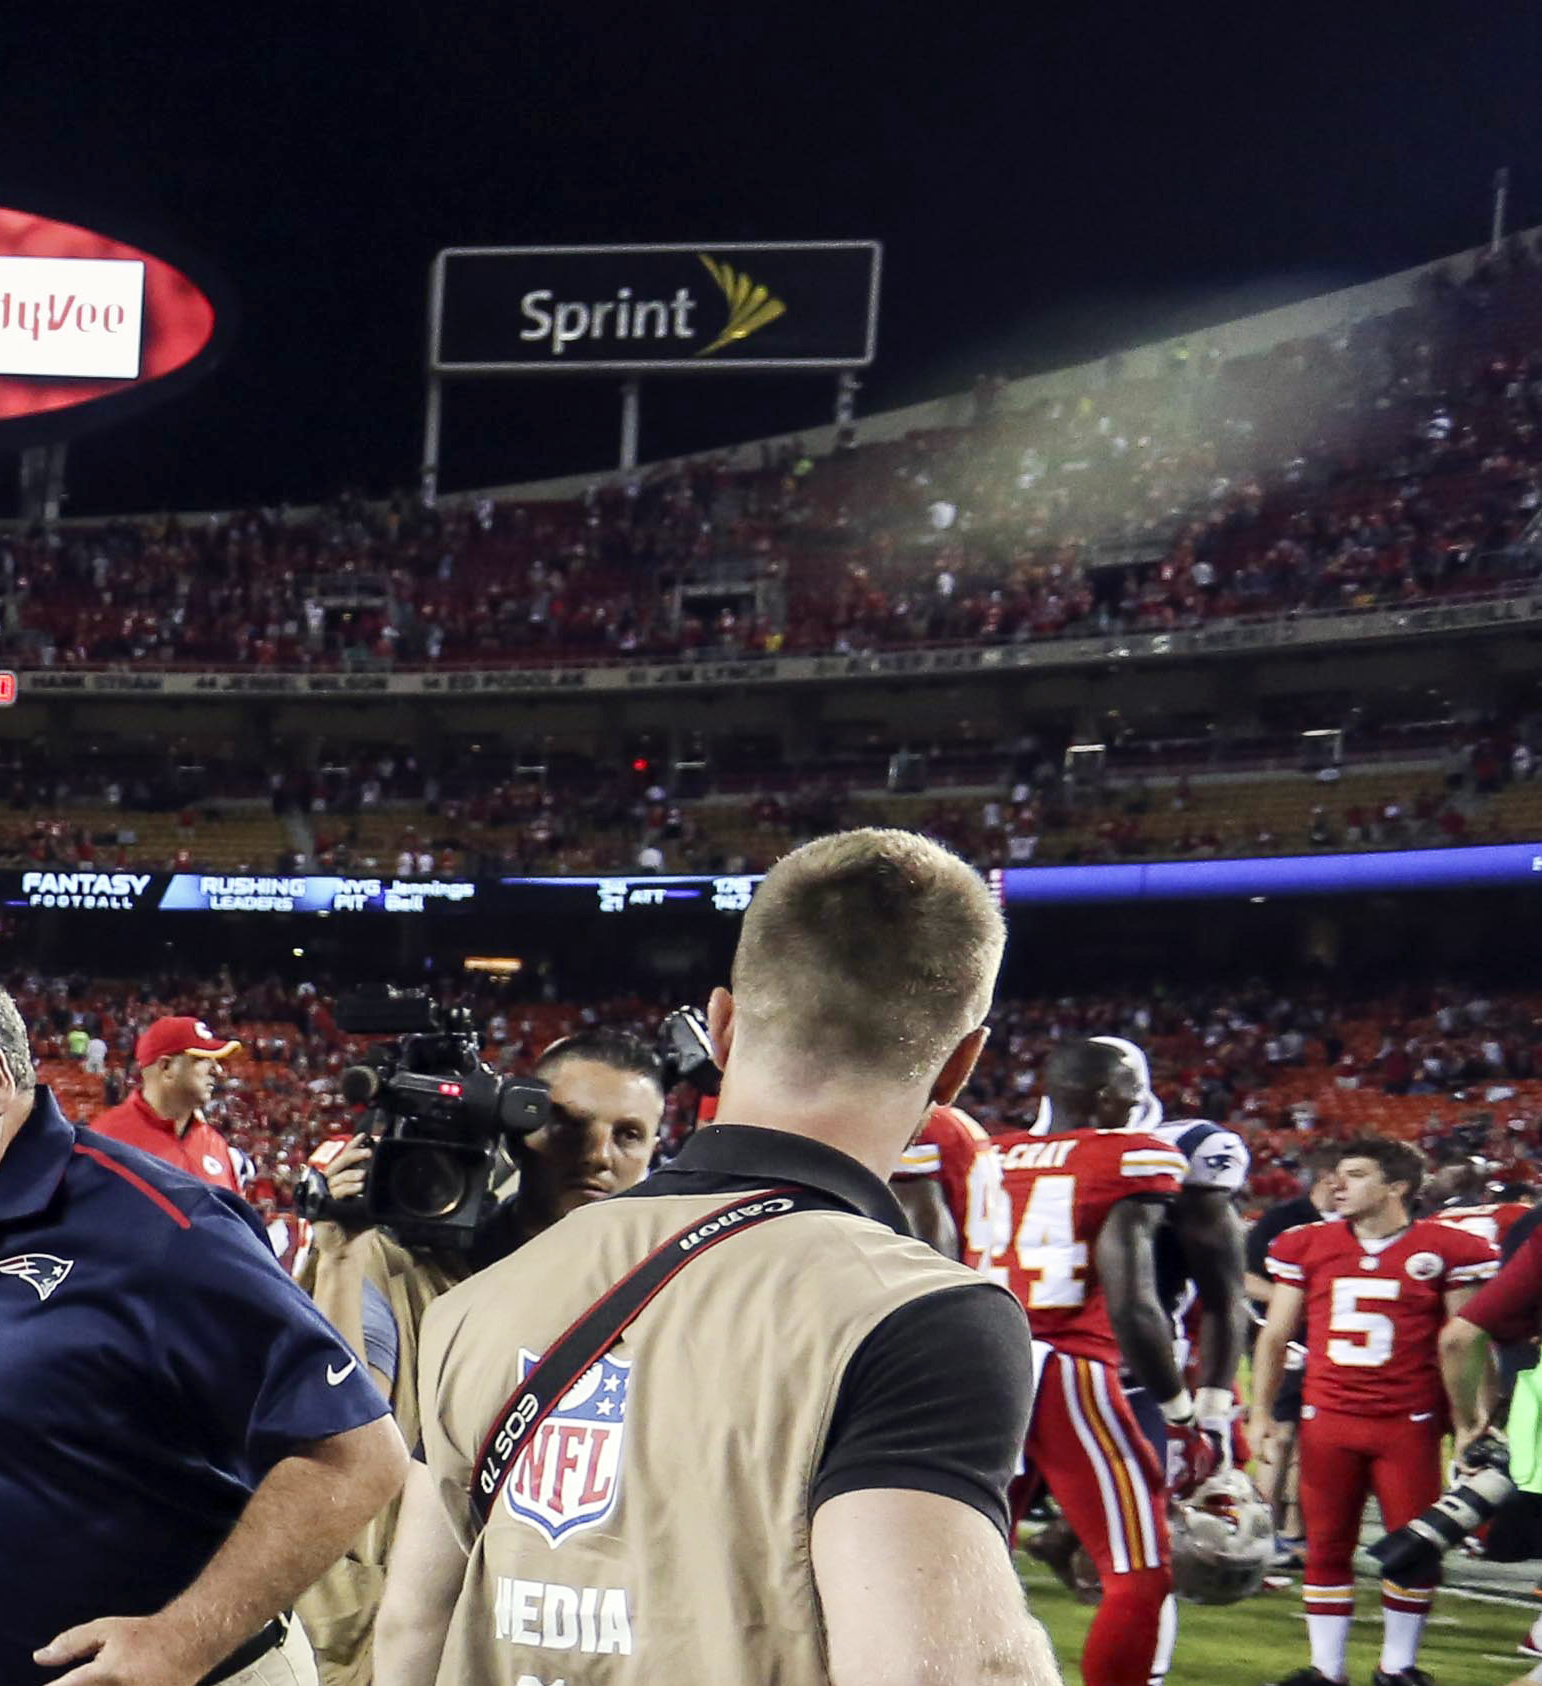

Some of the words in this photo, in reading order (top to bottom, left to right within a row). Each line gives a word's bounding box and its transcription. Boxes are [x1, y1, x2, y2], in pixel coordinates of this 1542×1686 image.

[519, 287, 697, 355] Sprint
[22, 871, 151, 896] FANTASY
[199, 876, 306, 897] RUSHING
[335, 879, 381, 896] NYG
[628, 888, 667, 904] ATT
[29, 894, 134, 908] FOOTBALL
[209, 896, 294, 911] LEADERS
[333, 893, 368, 912] PIT
[678, 1196, 796, 1252] Canon
[1326, 1276, 1402, 1368] 5
[494, 1392, 540, 1464] EOS
[479, 1462, 503, 1496] 7D
[514, 1422, 613, 1515] NFL
